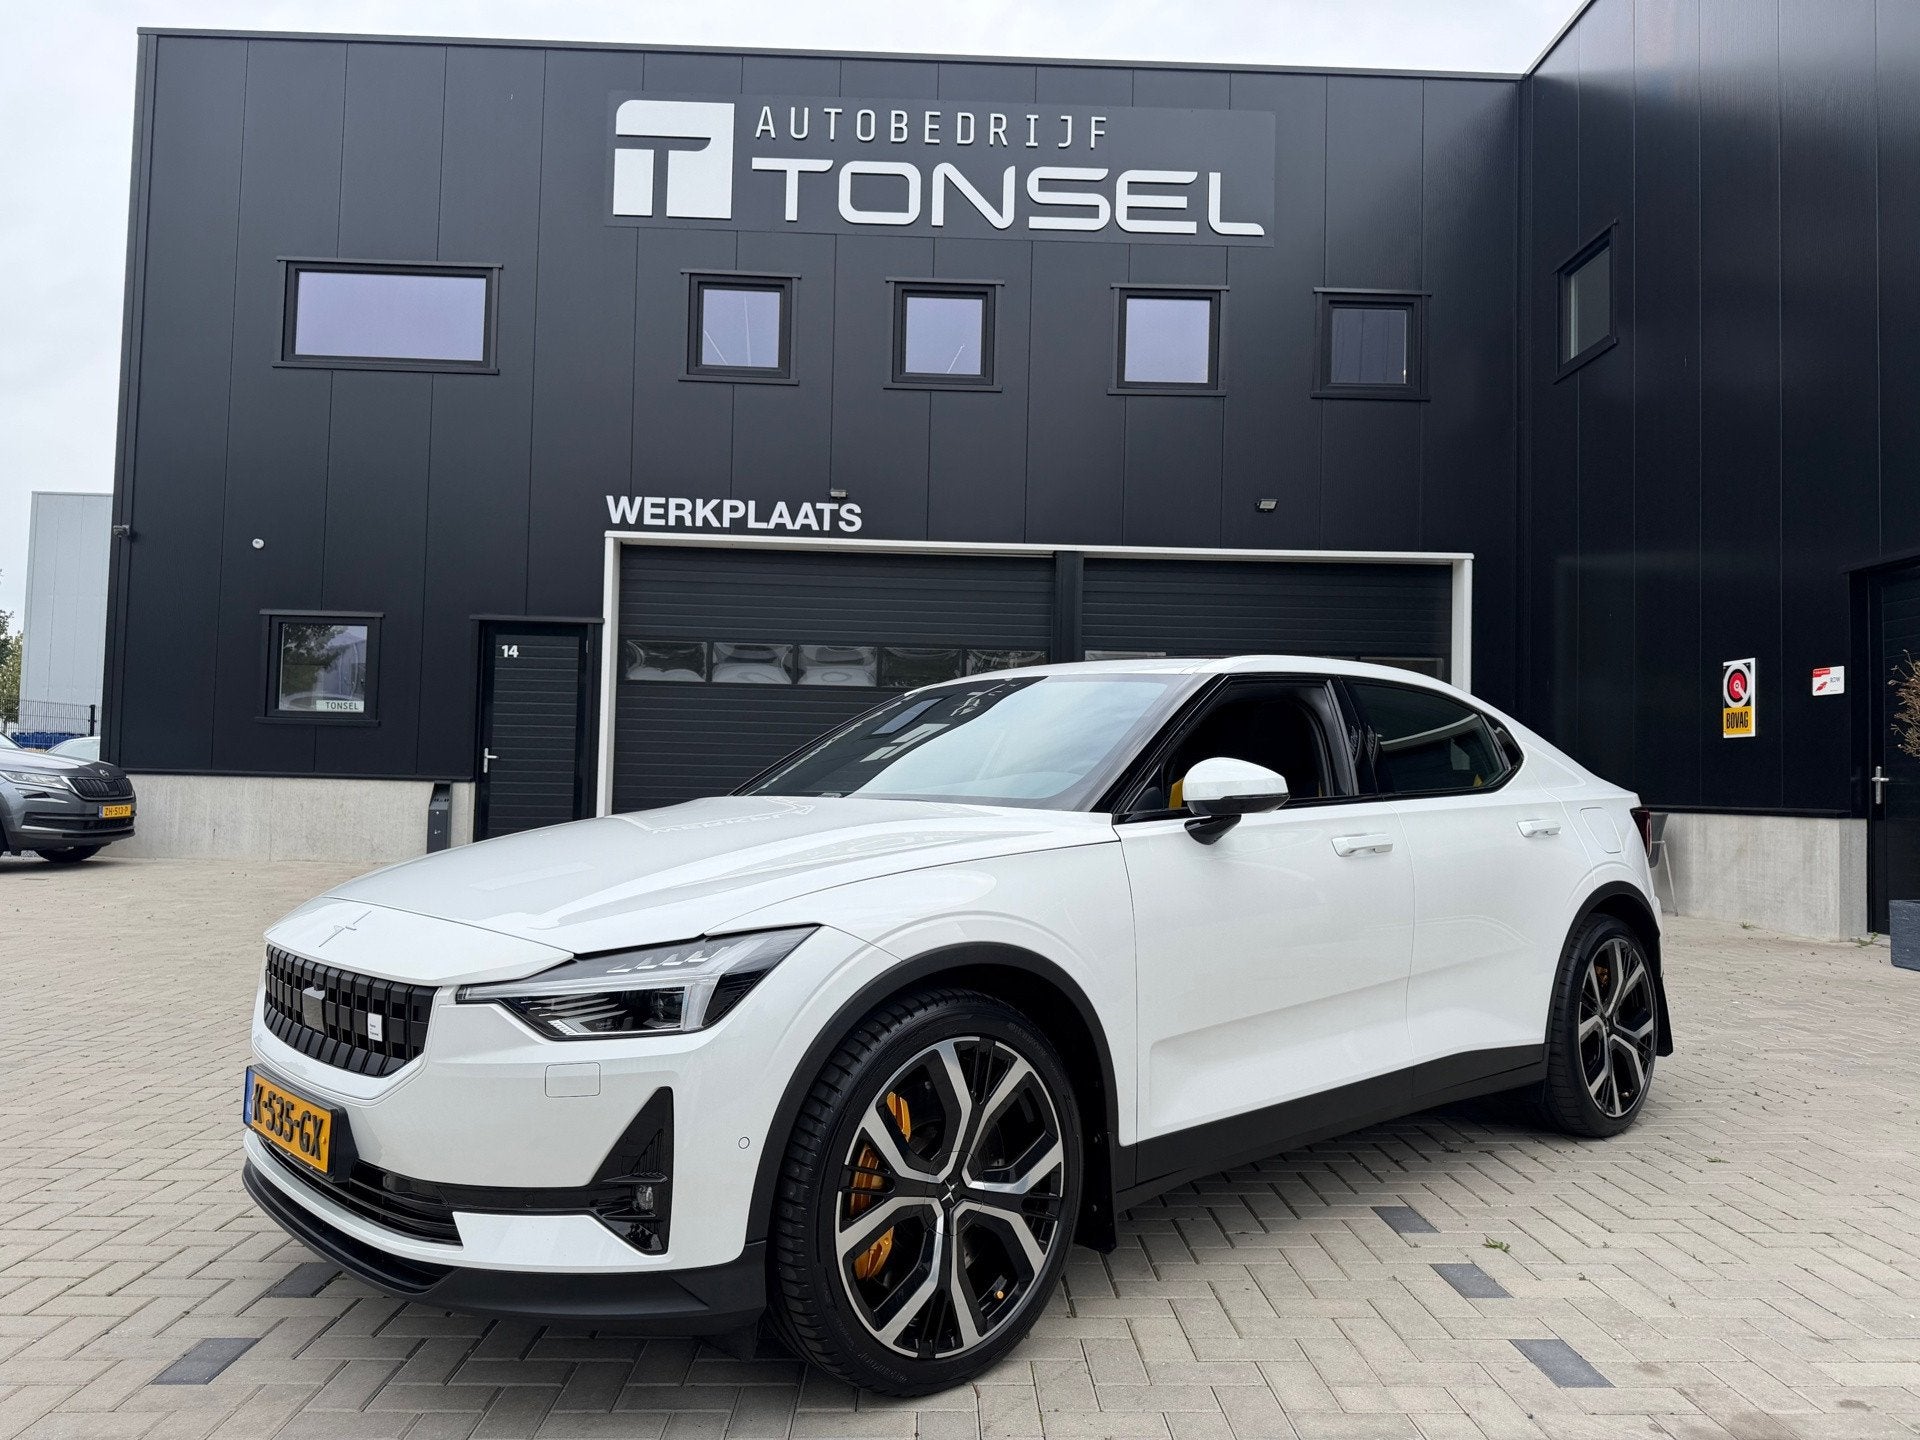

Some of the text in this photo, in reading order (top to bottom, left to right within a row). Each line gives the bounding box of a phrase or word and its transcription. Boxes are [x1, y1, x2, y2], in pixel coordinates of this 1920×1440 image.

[755, 105, 1107, 149] AUTOBEDRIJF
[752, 156, 1266, 236] TONSEL
[605, 494, 862, 533] WERKPLAATS
[501, 644, 519, 658] 14
[325, 701, 358, 710] TONSEL
[1726, 711, 1749, 729] BOVAG
[253, 1083, 324, 1161] K-535-GX
